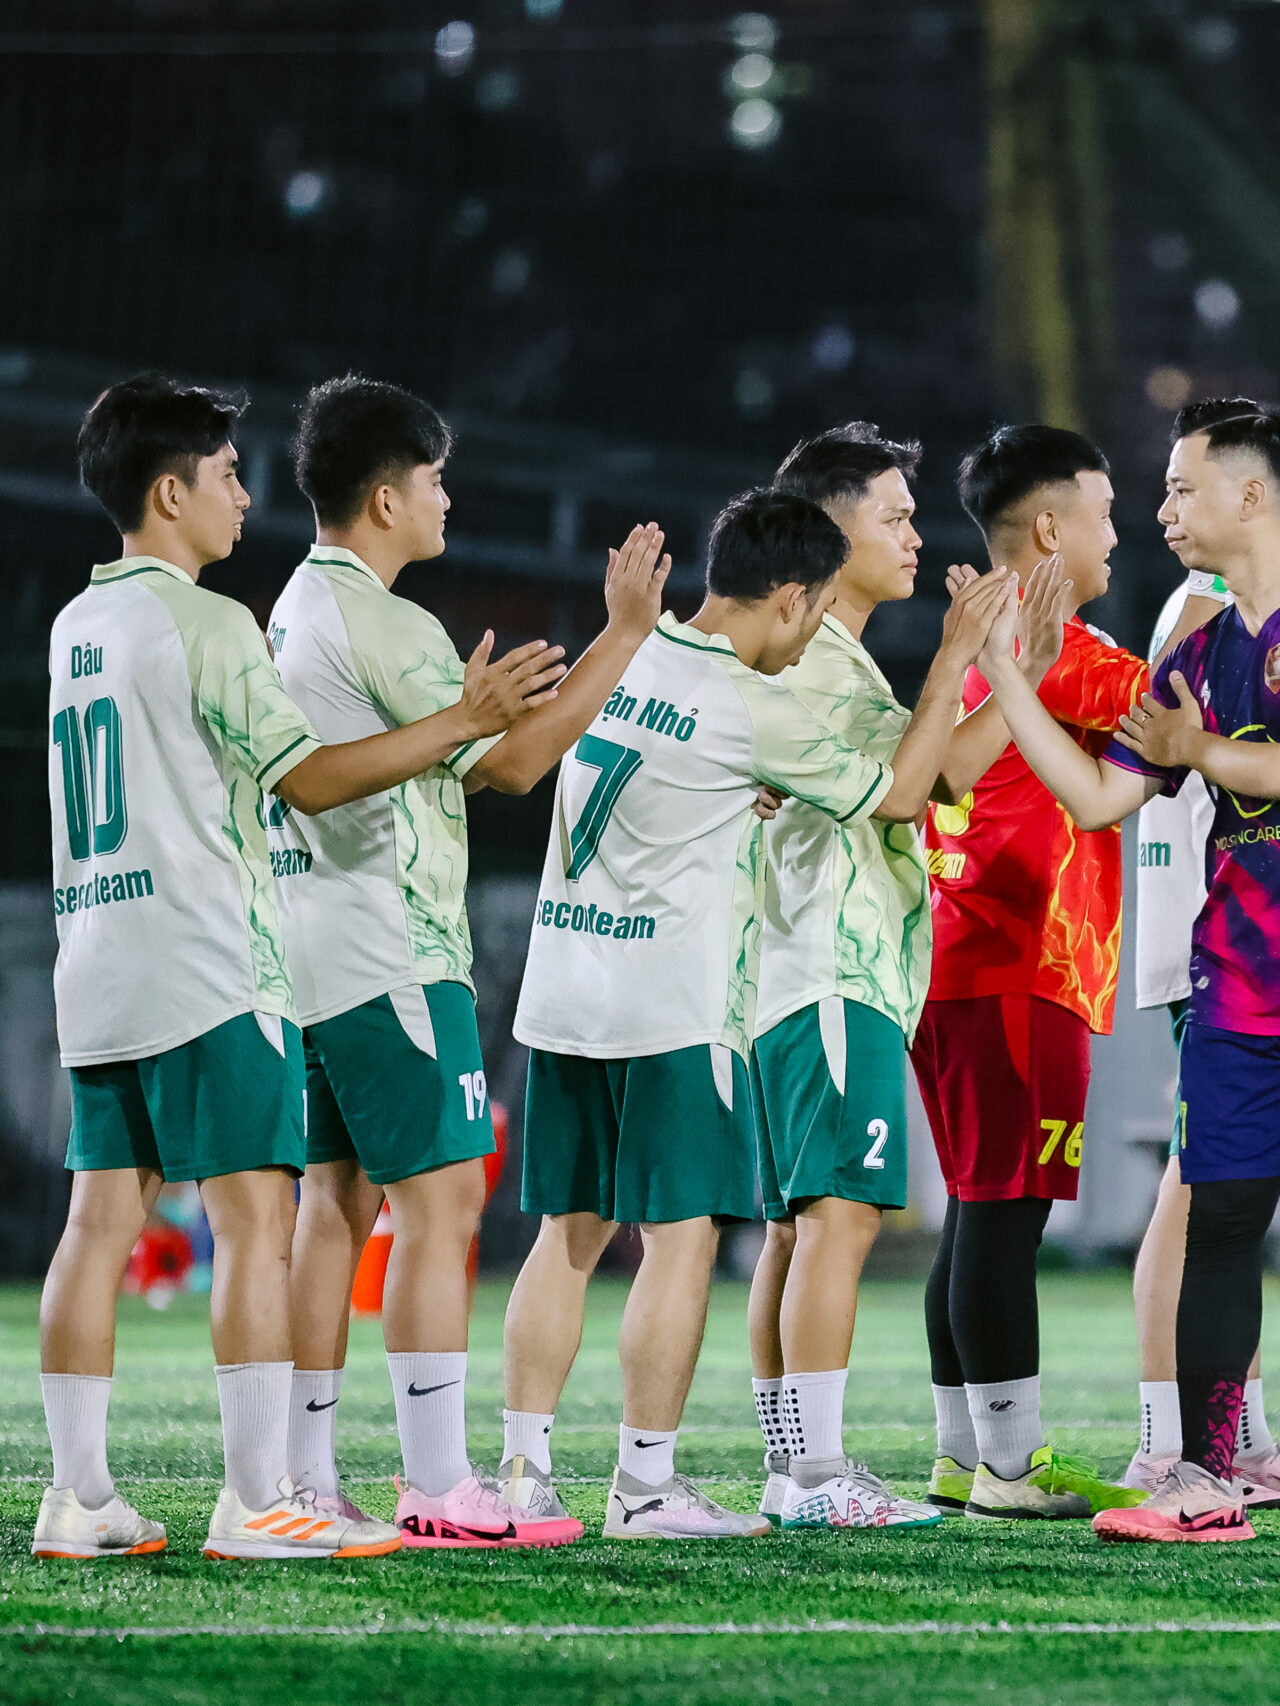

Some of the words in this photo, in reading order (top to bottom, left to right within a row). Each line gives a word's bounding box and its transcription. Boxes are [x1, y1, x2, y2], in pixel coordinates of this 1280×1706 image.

[71, 642, 103, 679] Dâu
[636, 697, 699, 742] Nhỏ
[53, 695, 129, 863] 10
[565, 732, 644, 884] 7
[458, 1069, 487, 1121] 19
[863, 1118, 889, 1170] 2
[1038, 1119, 1084, 1168] 76
